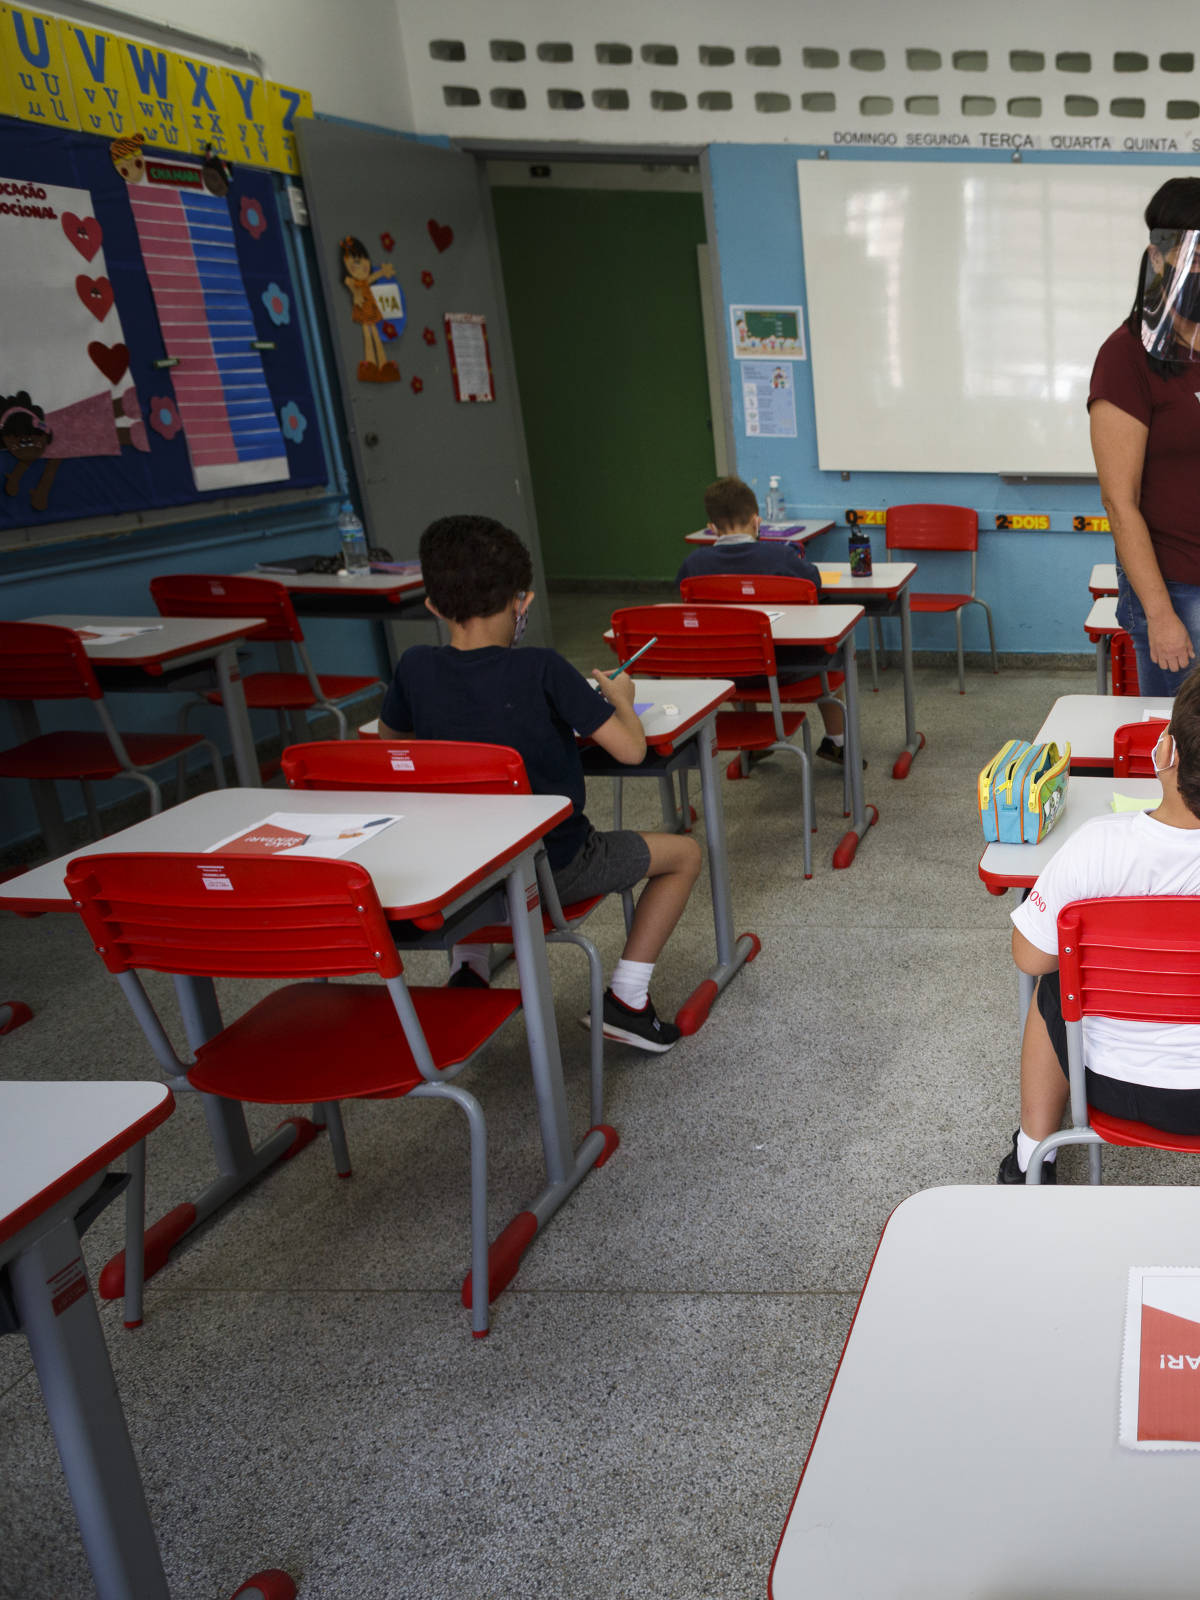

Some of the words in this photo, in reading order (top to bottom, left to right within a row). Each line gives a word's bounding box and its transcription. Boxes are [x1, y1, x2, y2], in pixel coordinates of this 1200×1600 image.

[11, 10, 50, 69] U
[73, 28, 106, 83] V
[126, 43, 168, 99] W
[184, 60, 217, 112] X
[231, 74, 254, 121] Y
[279, 88, 300, 132] Z
[833, 131, 898, 145] DOMINGO
[906, 133, 970, 146] SEGUNDA
[1051, 135, 1112, 149] QUARTA
[1124, 137, 1179, 151] QUINTA
